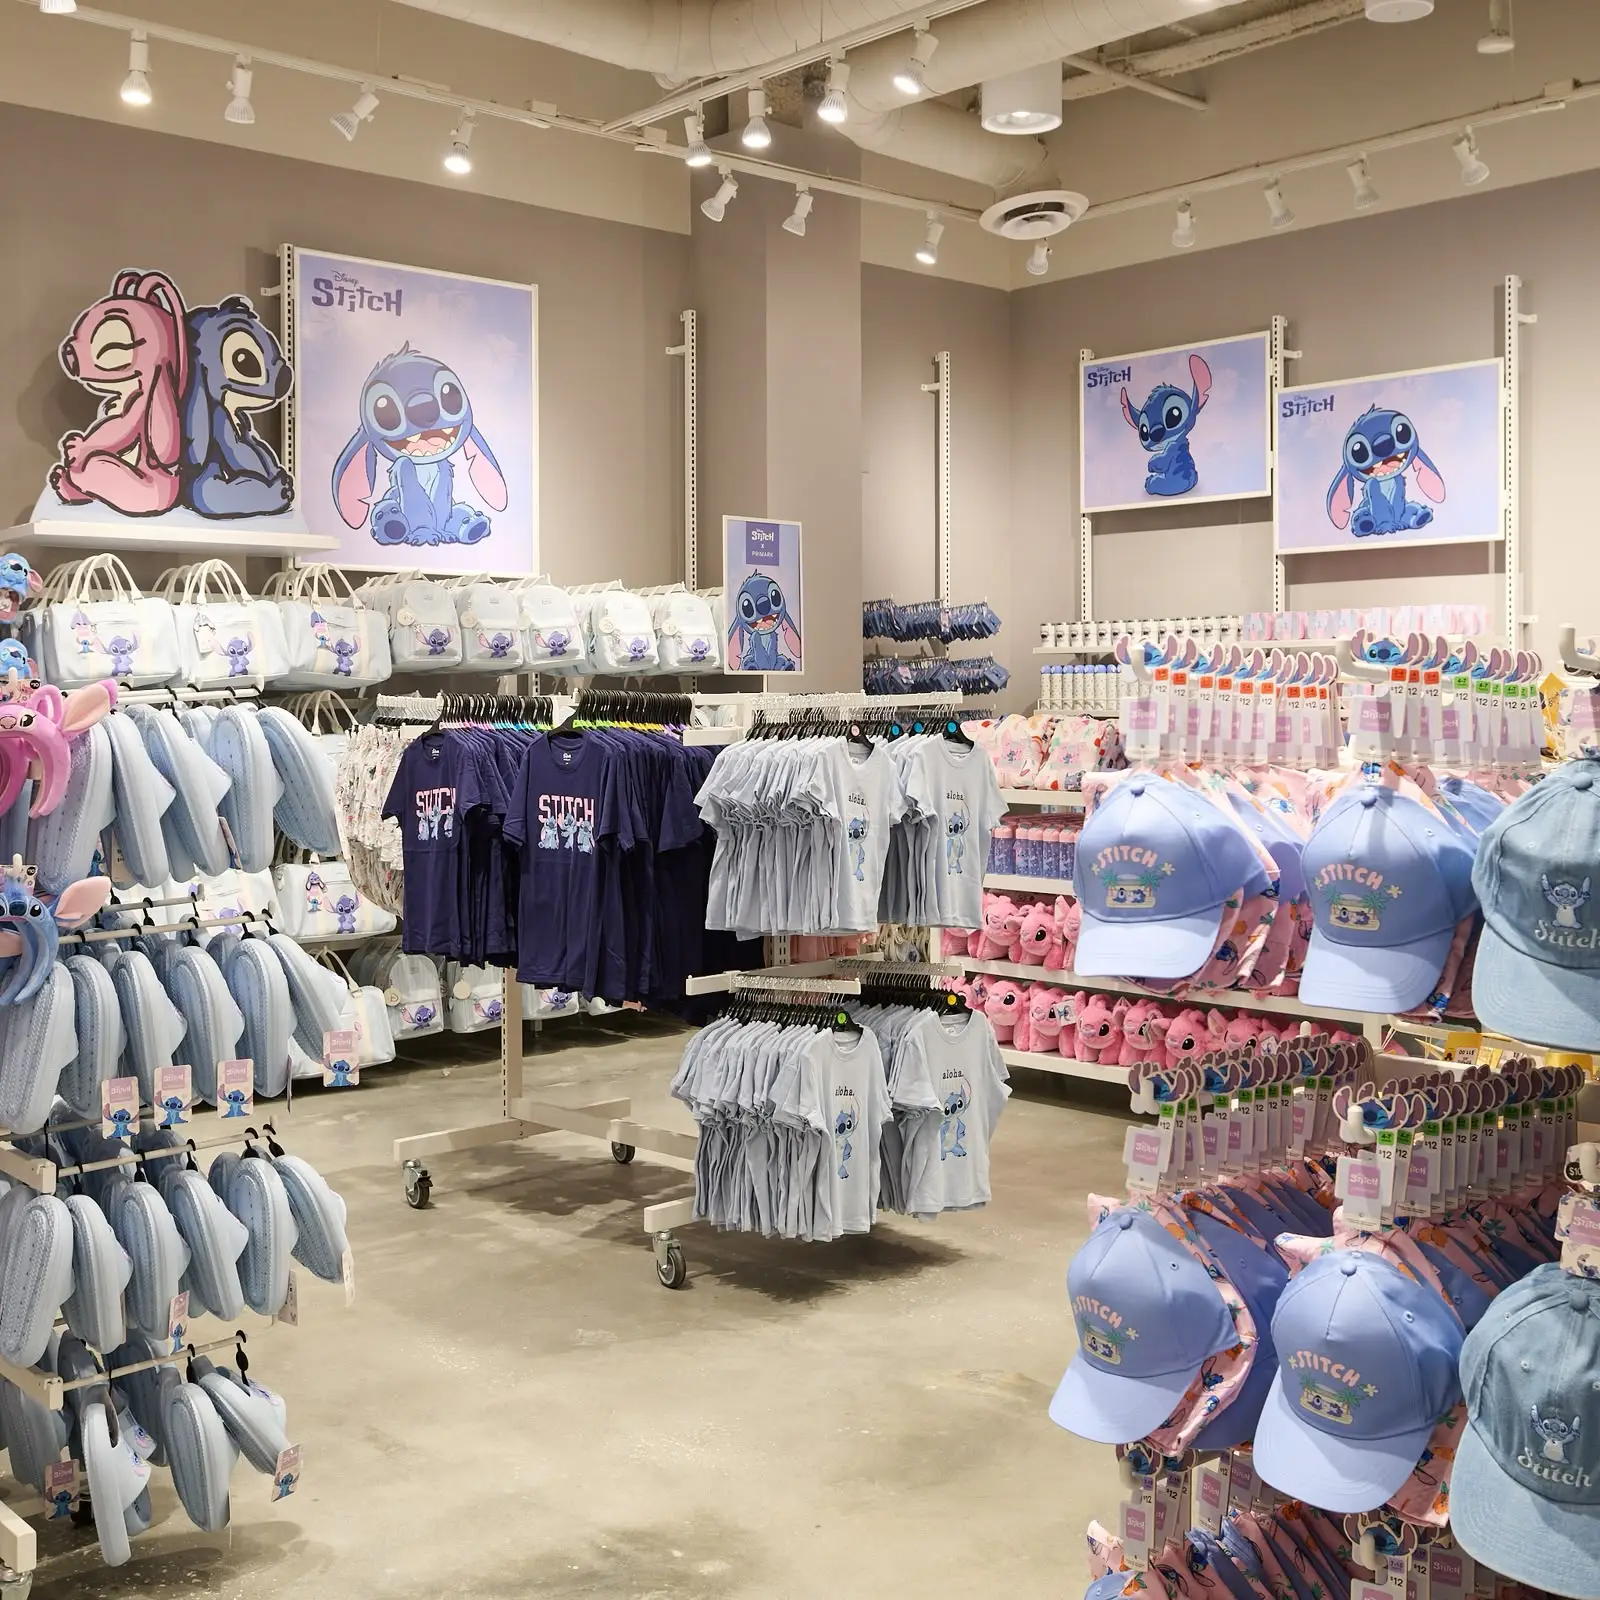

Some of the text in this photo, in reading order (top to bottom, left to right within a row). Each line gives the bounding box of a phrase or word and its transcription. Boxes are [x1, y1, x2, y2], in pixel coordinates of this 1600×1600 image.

[332, 270, 359, 286] Disney
[752, 550, 774, 558] PRIMARK
[1408, 688, 1418, 696] 12
[1456, 692, 1468, 700] $12
[1476, 698, 1488, 706] $12
[1505, 701, 1518, 709] $12
[538, 794, 595, 828] STITCH
[1096, 845, 1159, 869] STITCH
[1319, 863, 1384, 890] STITCH
[1256, 1104, 1264, 1112] 12
[1268, 1102, 1278, 1110] 12
[1176, 1120, 1184, 1128] 12
[1521, 1120, 1530, 1129] 12
[1442, 1138, 1452, 1146] 12
[1457, 1135, 1467, 1144] 12
[1424, 1141, 1438, 1150] $12
[1380, 1149, 1392, 1160] $12
[1075, 1295, 1123, 1329] STITCH
[1296, 1350, 1361, 1387] STITCH
[1517, 1447, 1593, 1488] Stitch
[1166, 1488, 1178, 1500] $12
[1414, 1564, 1427, 1575] $12
[1390, 1576, 1404, 1587] $12
